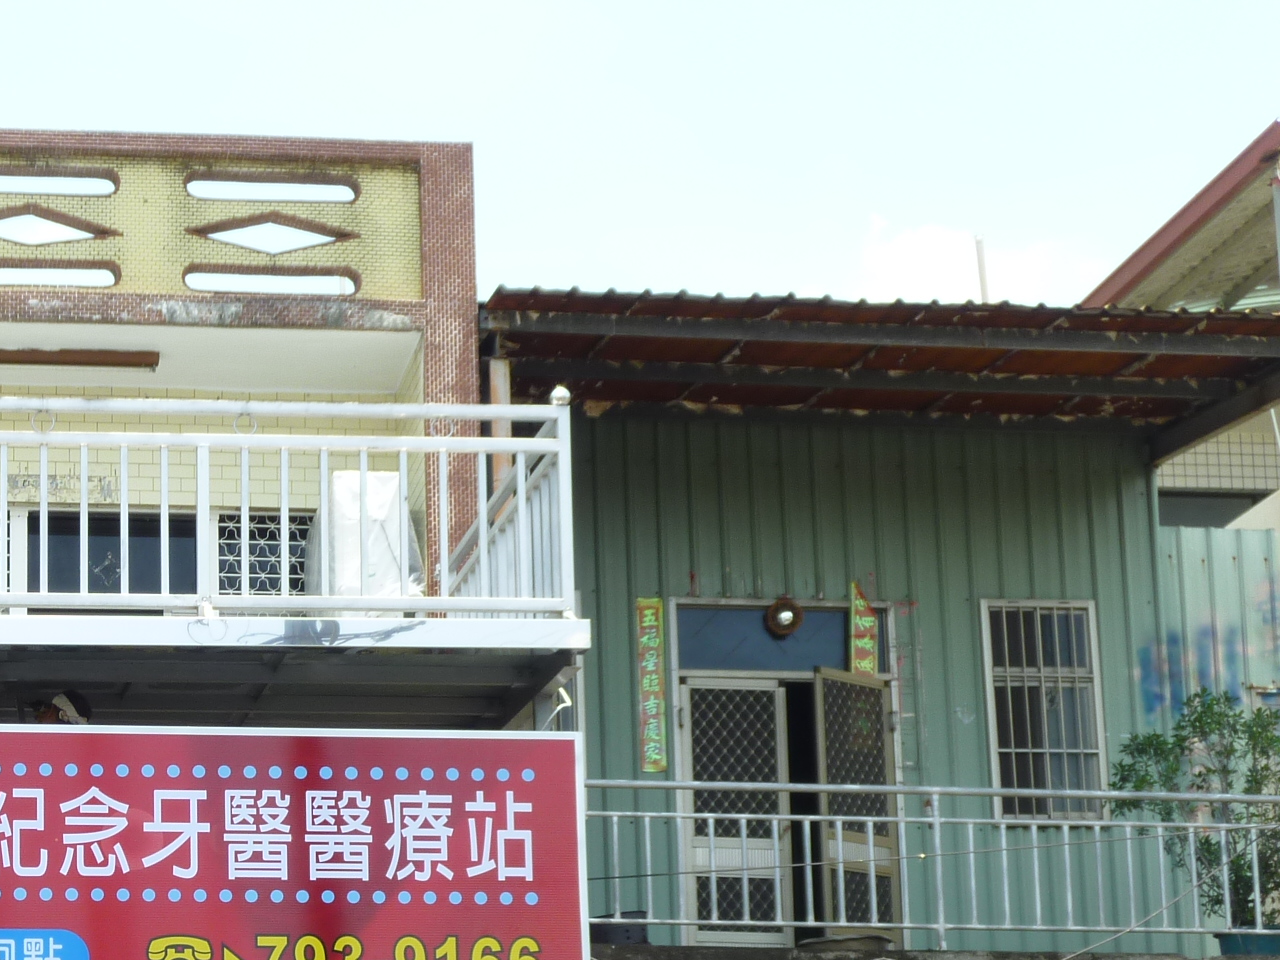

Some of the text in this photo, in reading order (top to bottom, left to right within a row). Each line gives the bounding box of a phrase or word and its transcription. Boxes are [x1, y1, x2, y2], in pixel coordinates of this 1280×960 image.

[640, 608, 663, 763] 五福星臨吉慶家
